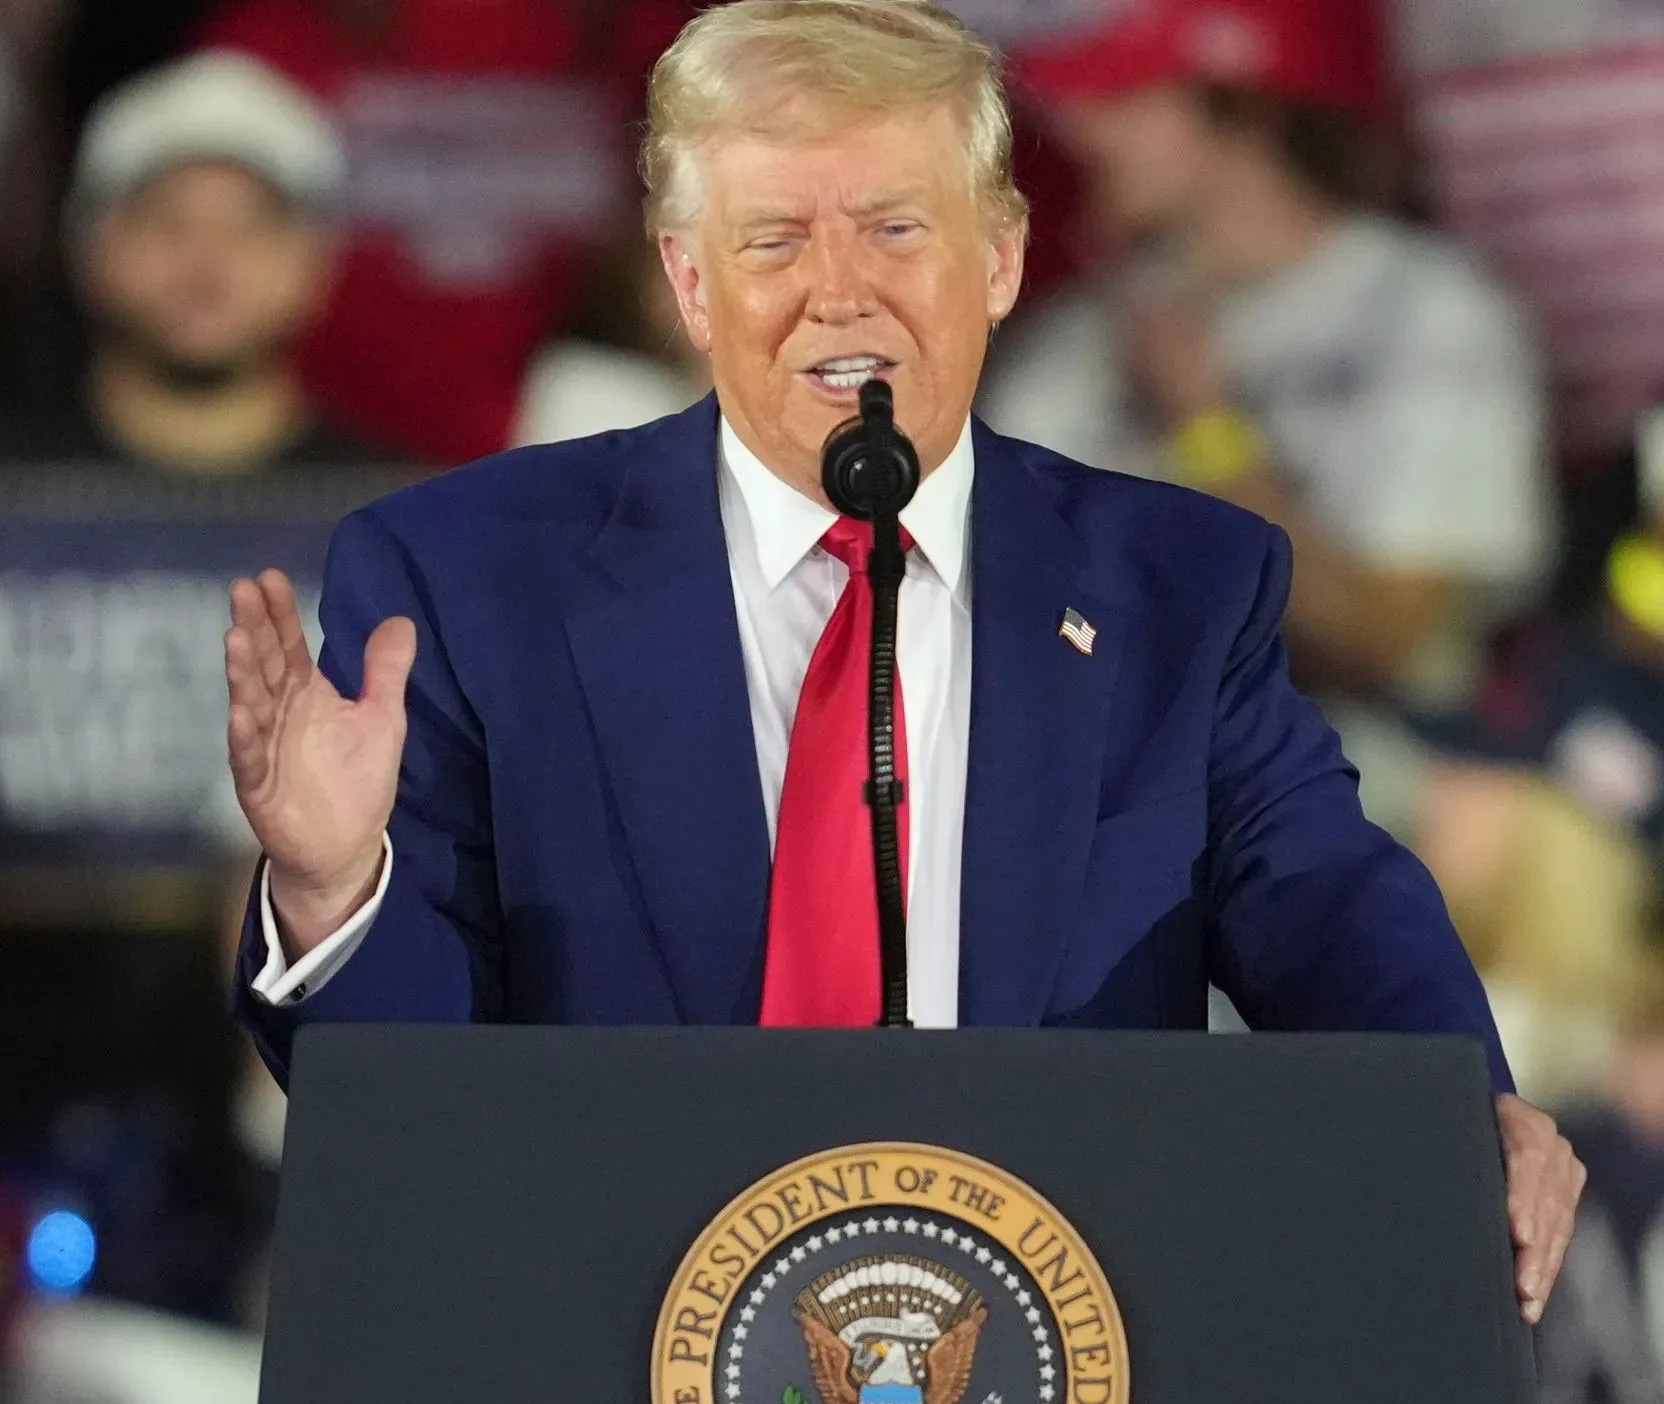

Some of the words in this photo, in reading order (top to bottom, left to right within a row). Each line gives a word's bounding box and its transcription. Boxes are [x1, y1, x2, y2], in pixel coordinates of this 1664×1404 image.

[670, 1161, 879, 1368] PRESIDENT
[894, 1165, 938, 1194] OF
[949, 1175, 1008, 1221] THE
